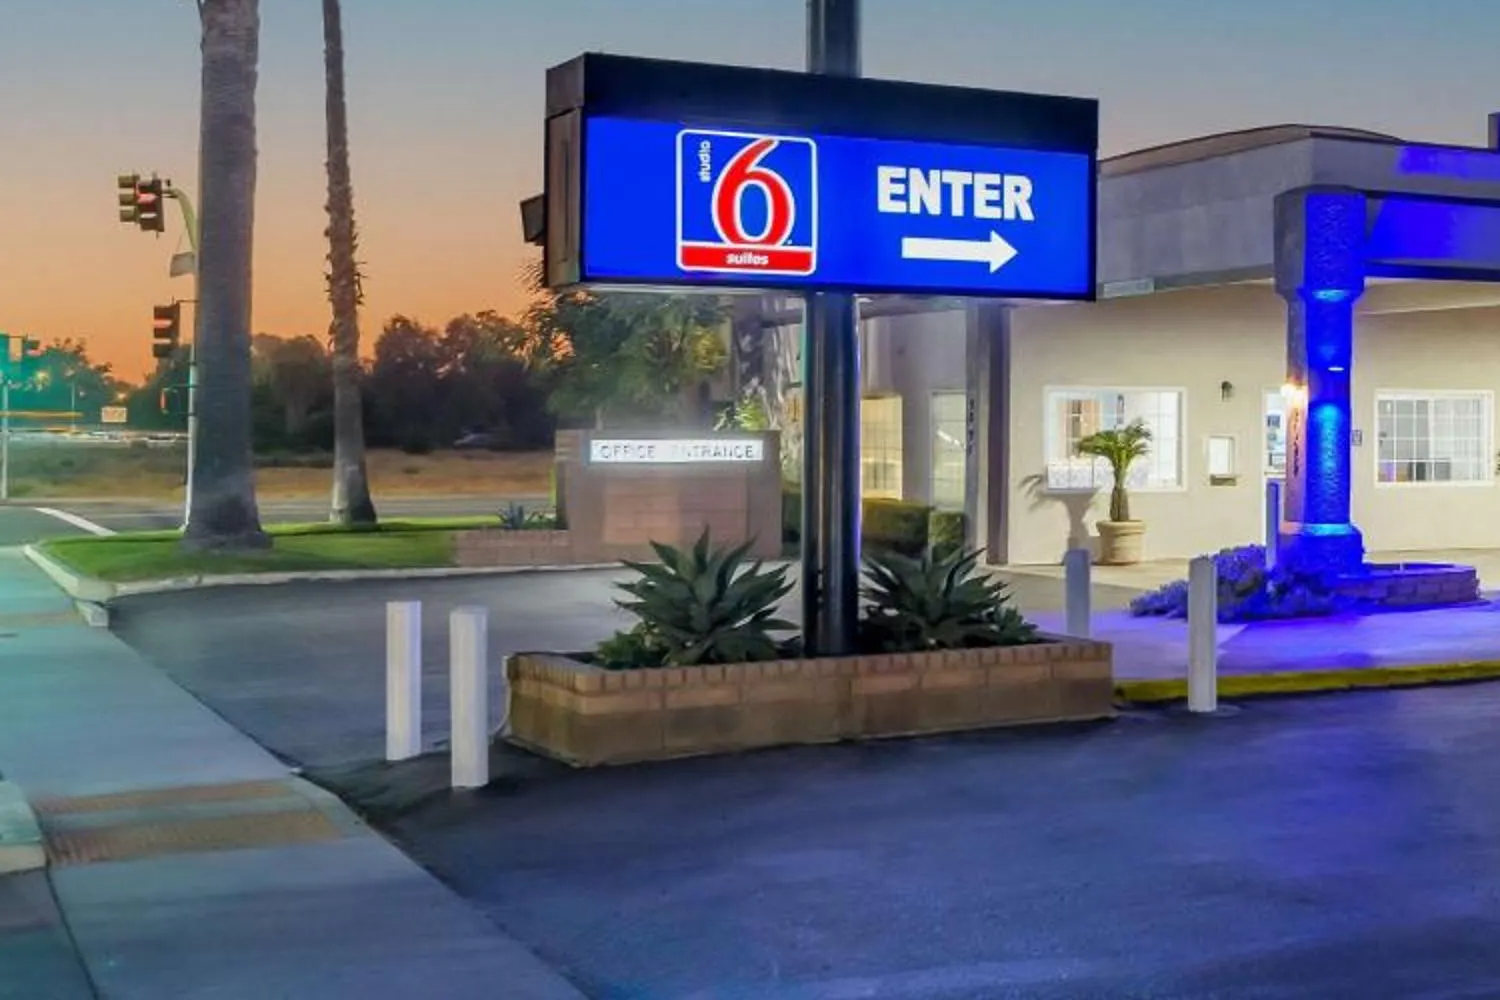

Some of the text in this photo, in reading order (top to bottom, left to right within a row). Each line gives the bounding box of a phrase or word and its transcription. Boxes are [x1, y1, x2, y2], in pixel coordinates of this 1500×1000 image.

[698, 140, 711, 182] studio
[711, 136, 795, 246] 6
[877, 165, 1035, 221] ENTER
[726, 252, 769, 265] suites
[600, 444, 753, 459] OFFCE NTRANCE
